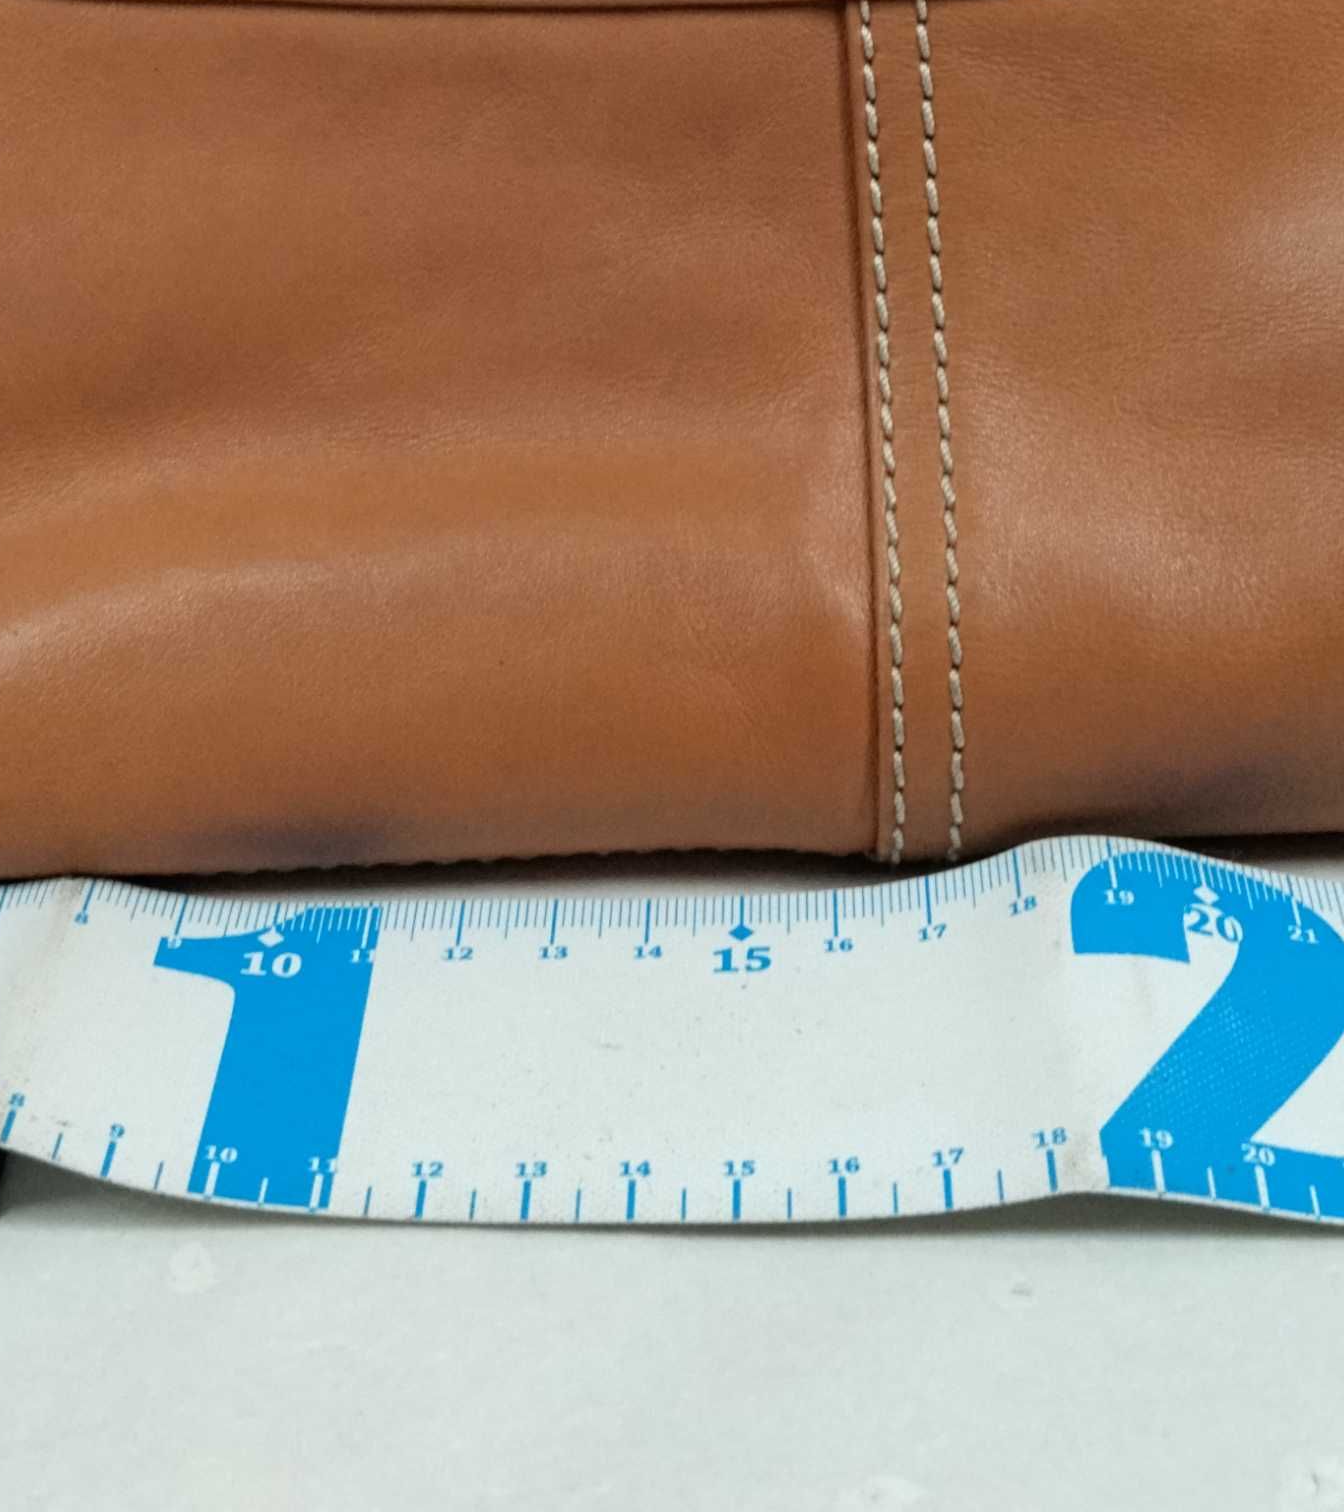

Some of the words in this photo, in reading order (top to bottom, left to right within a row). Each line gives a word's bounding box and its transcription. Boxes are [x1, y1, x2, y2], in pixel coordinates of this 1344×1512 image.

[239, 952, 303, 979] 10
[349, 948, 375, 963] 11
[441, 947, 474, 961] 12
[538, 946, 569, 960] 13
[633, 945, 663, 959] 14
[712, 947, 774, 973] 15
[823, 937, 854, 953] 16
[917, 923, 948, 942] 17
[1008, 896, 1039, 917] 18
[1103, 889, 1135, 906] 19
[1183, 906, 1243, 943] 20
[1287, 924, 1320, 945] 21
[153, 906, 383, 1209] 1
[9, 1092, 26, 1107] 8
[110, 1123, 126, 1138] 9
[204, 1145, 239, 1164] 10
[308, 1156, 338, 1173] 11
[411, 1161, 444, 1178] 12
[515, 1161, 547, 1178] 13
[618, 1160, 652, 1177] 14
[723, 1160, 755, 1176] 15
[827, 1157, 860, 1175] 16
[931, 1148, 965, 1167] 17
[1033, 1128, 1067, 1149] 18
[1138, 1128, 1174, 1150] 19
[1240, 1143, 1276, 1167] 20
